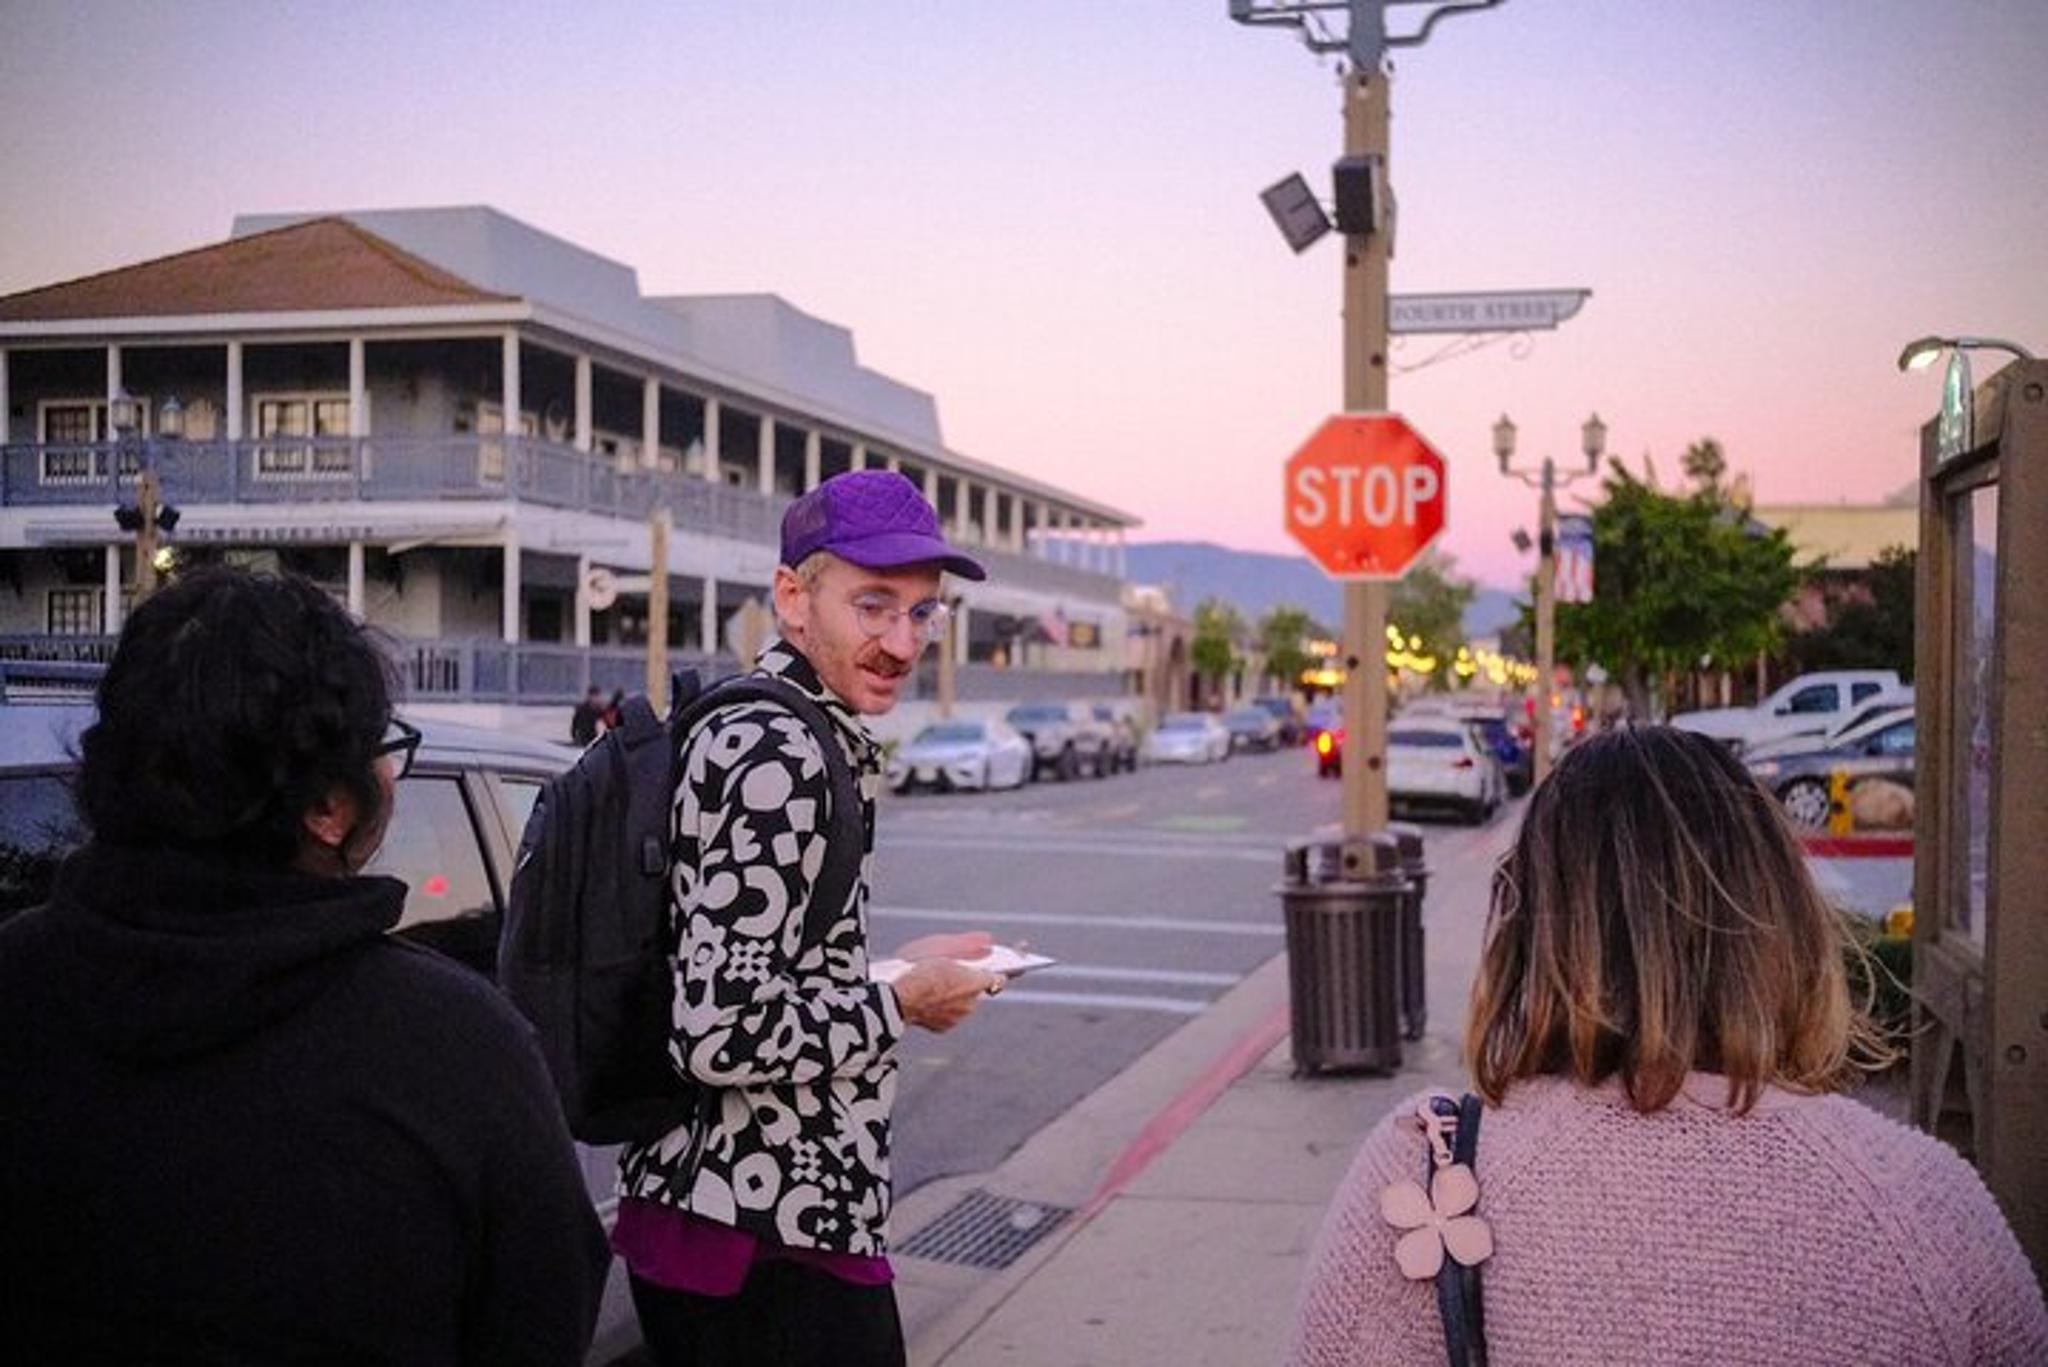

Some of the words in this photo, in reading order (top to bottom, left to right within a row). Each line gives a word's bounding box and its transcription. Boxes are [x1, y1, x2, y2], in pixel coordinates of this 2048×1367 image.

[1394, 304, 1477, 321] FOURTH
[1485, 302, 1558, 319] STREET
[1295, 465, 1439, 527] STOP
